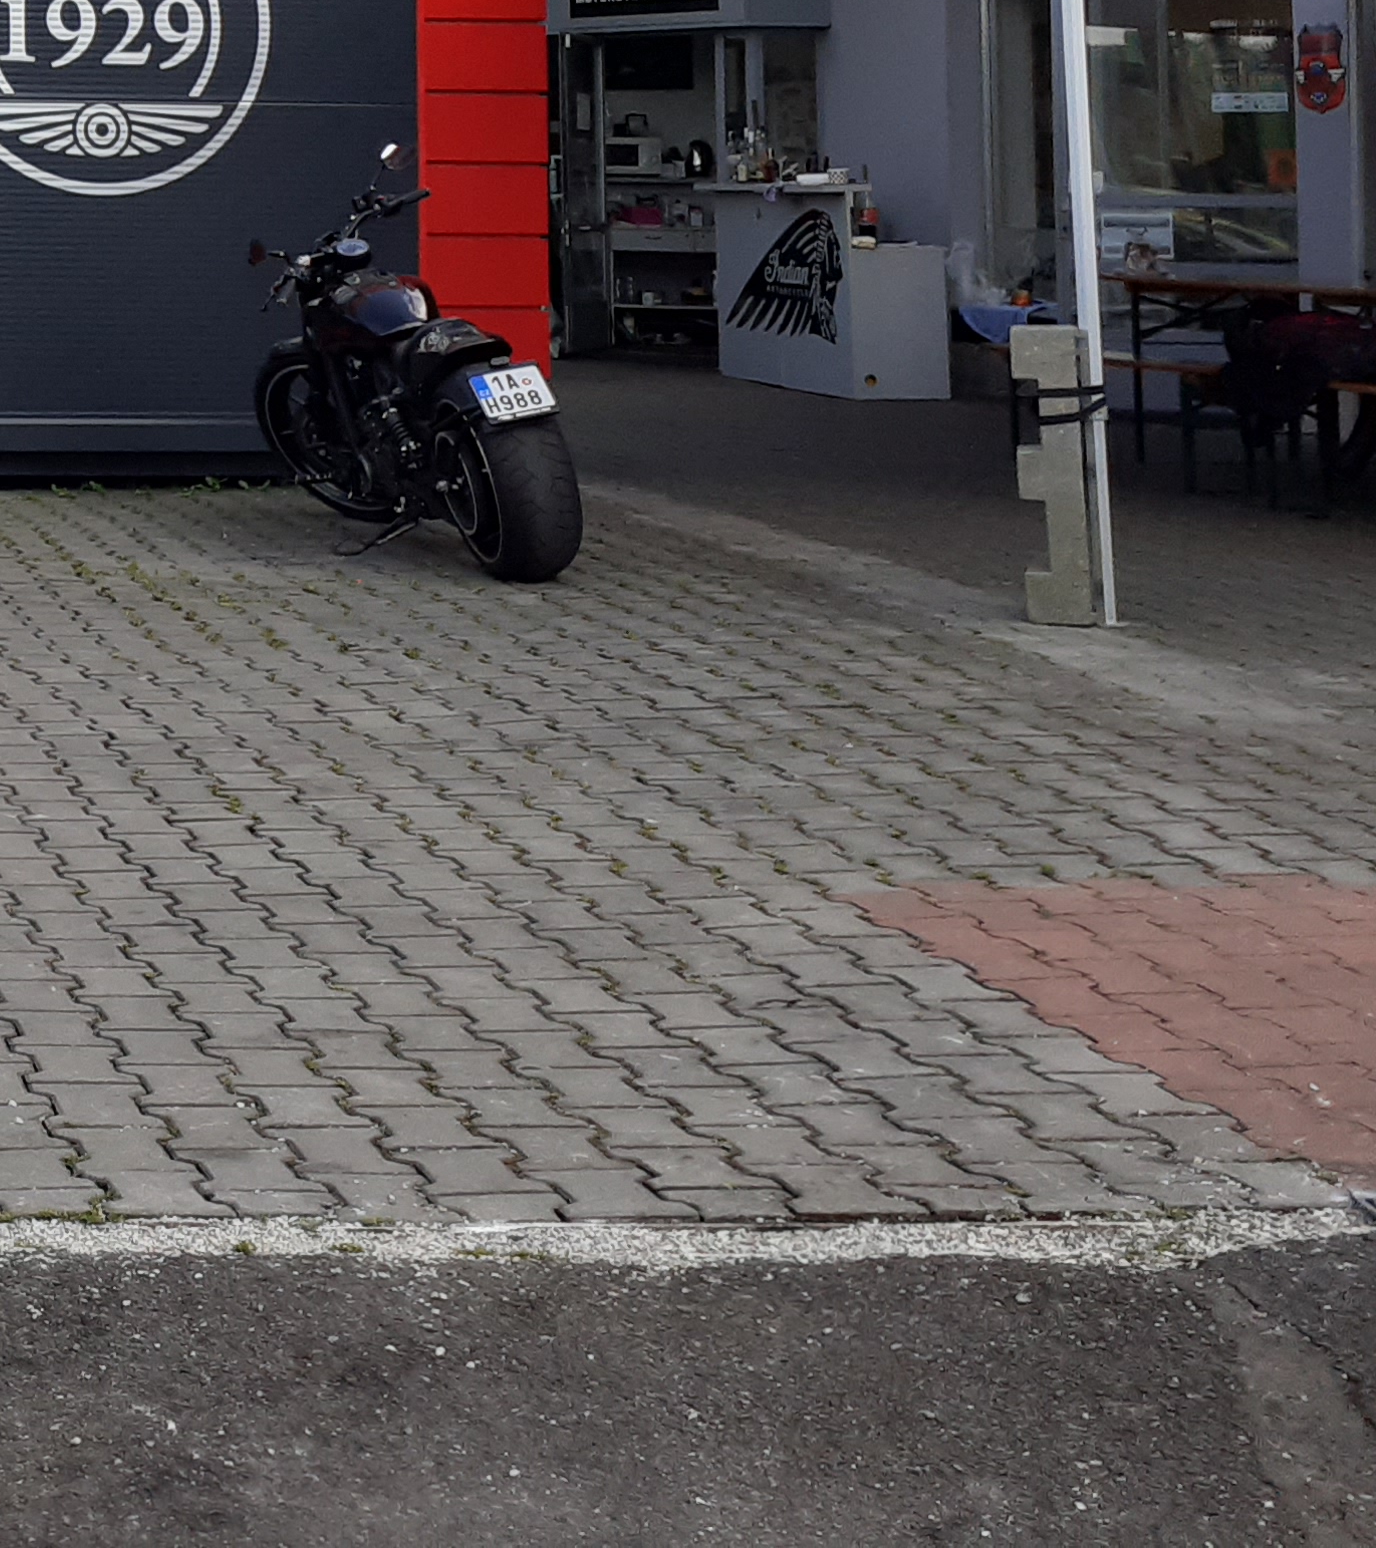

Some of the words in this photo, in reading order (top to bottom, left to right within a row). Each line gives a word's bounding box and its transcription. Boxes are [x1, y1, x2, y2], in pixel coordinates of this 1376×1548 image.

[764, 249, 810, 285] Indian
[491, 373, 520, 391] 1A
[485, 389, 543, 414] H988
